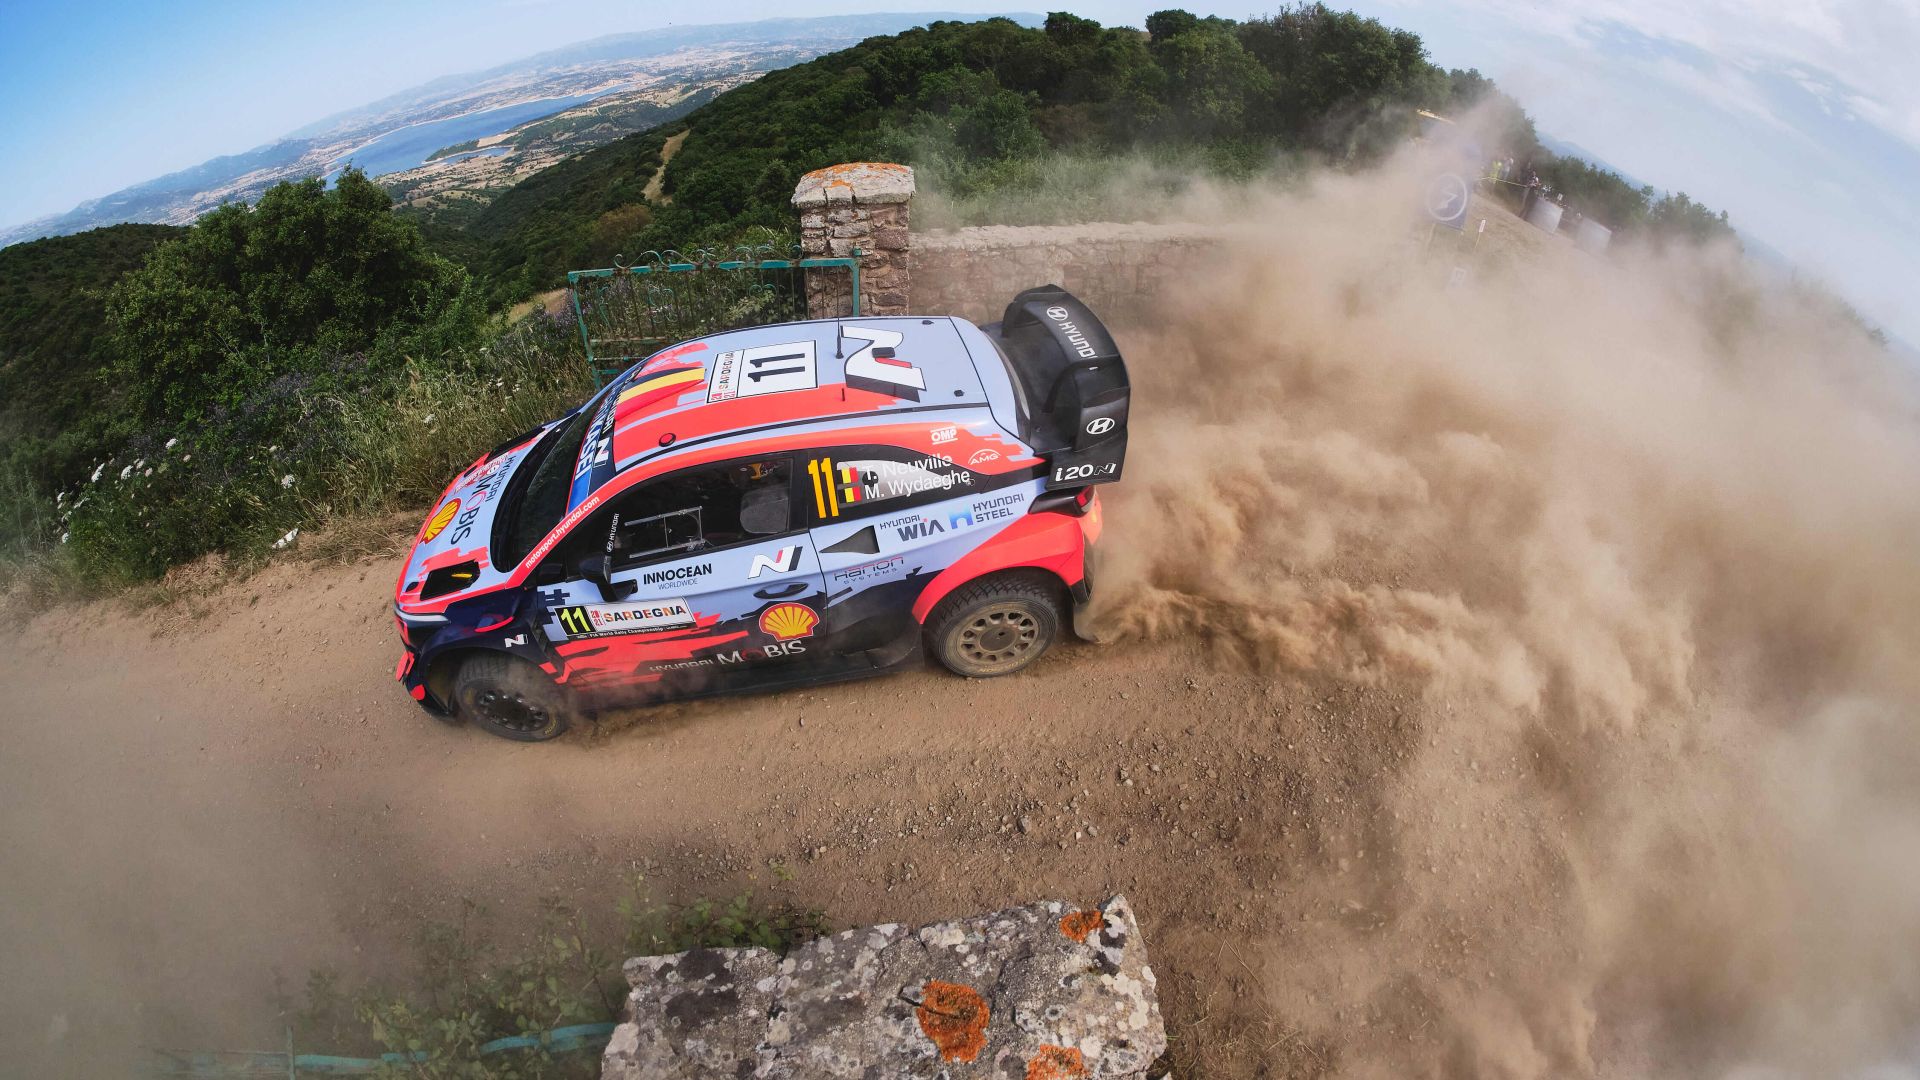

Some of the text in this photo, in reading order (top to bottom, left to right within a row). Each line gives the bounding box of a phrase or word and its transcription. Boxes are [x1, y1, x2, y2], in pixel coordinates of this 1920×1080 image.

[1059, 321, 1099, 370] HYUNDI
[748, 353, 805, 382] 11
[930, 427, 958, 444] OMP
[863, 453, 953, 481] T. Neuville
[808, 457, 839, 519] 11
[865, 469, 970, 500] M. Wydaeghe
[450, 473, 497, 545] MOBIS
[973, 494, 1024, 512] HYUNDAI
[976, 508, 1014, 523] STEEL
[525, 496, 600, 569] motorsport.hyundai.com
[609, 513, 619, 541] HYUNDAI
[879, 514, 921, 530] HYUNDAI
[643, 563, 713, 585] INNOCEAN
[657, 577, 698, 590] WORLDWIDE
[843, 567, 898, 585] SYSTEMS
[560, 607, 591, 633] 11
[604, 605, 687, 622] SARDEGNA
[649, 639, 806, 673] HYUNDAI MOBIS
